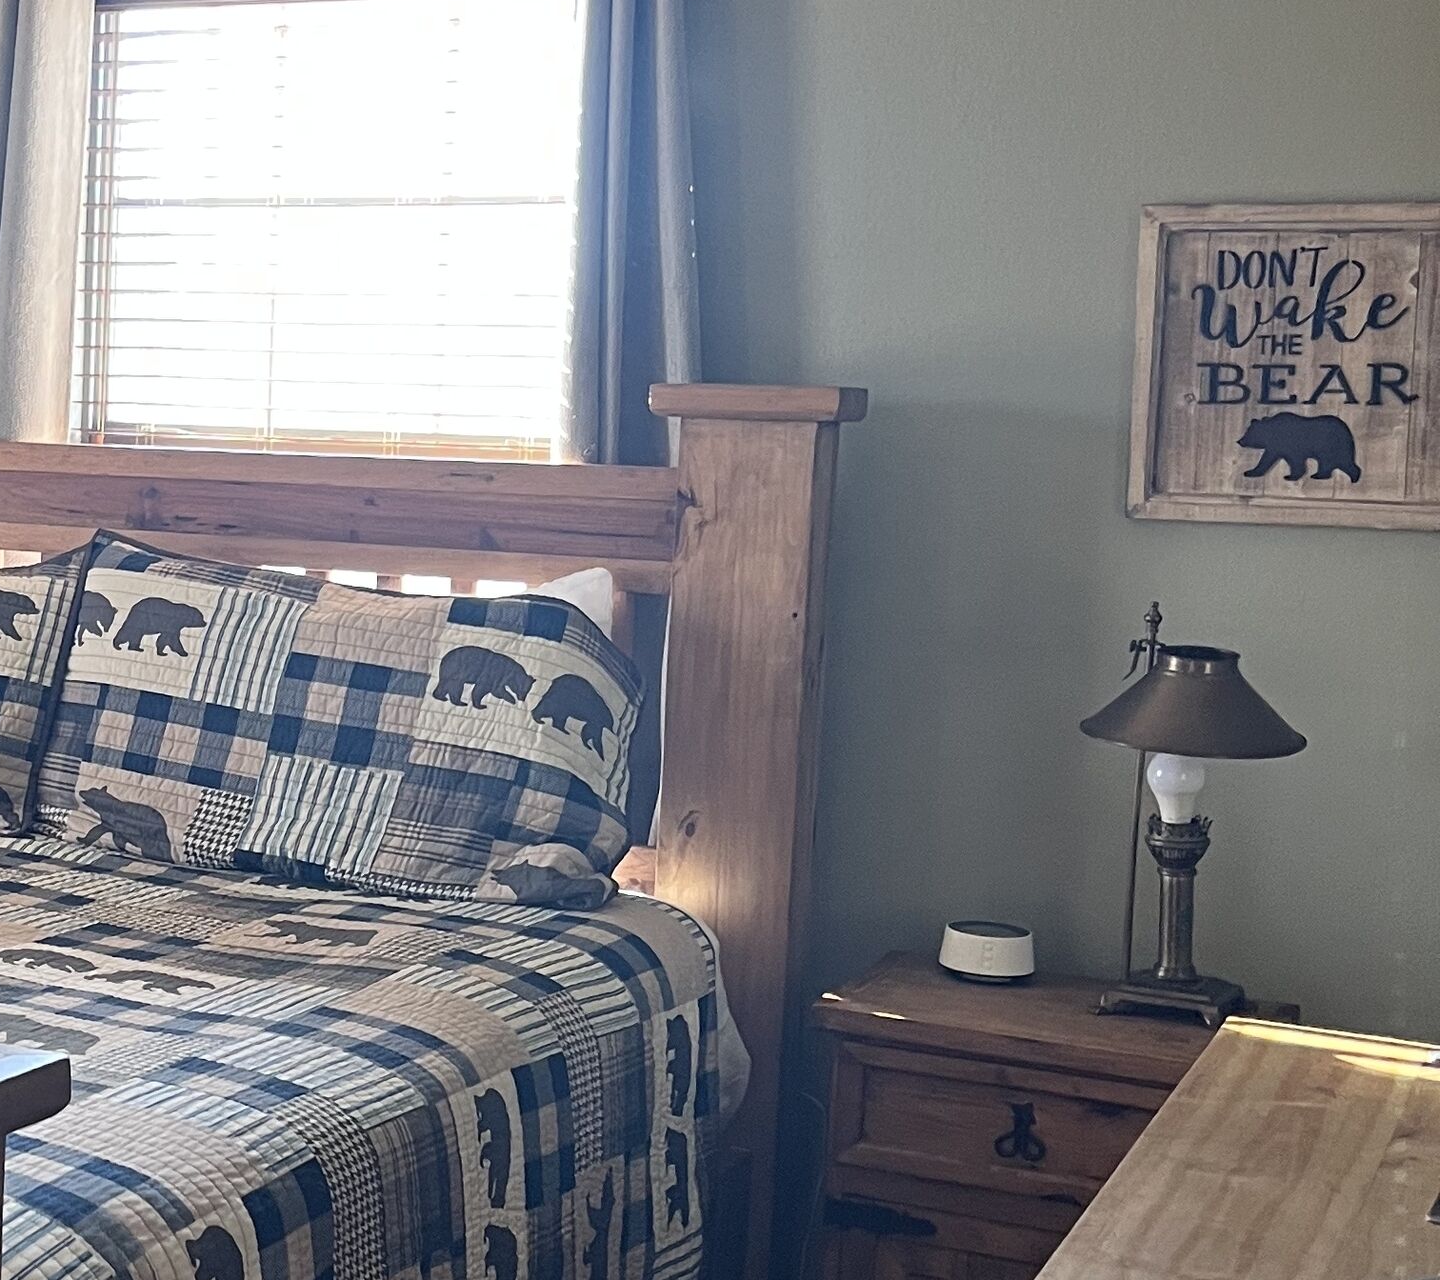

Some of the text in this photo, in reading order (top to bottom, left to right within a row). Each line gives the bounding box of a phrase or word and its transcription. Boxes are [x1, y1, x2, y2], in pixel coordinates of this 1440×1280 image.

[1217, 246, 1329, 291] DON'T
[1256, 334, 1303, 355] THE
[1196, 362, 1419, 406] BEAR
